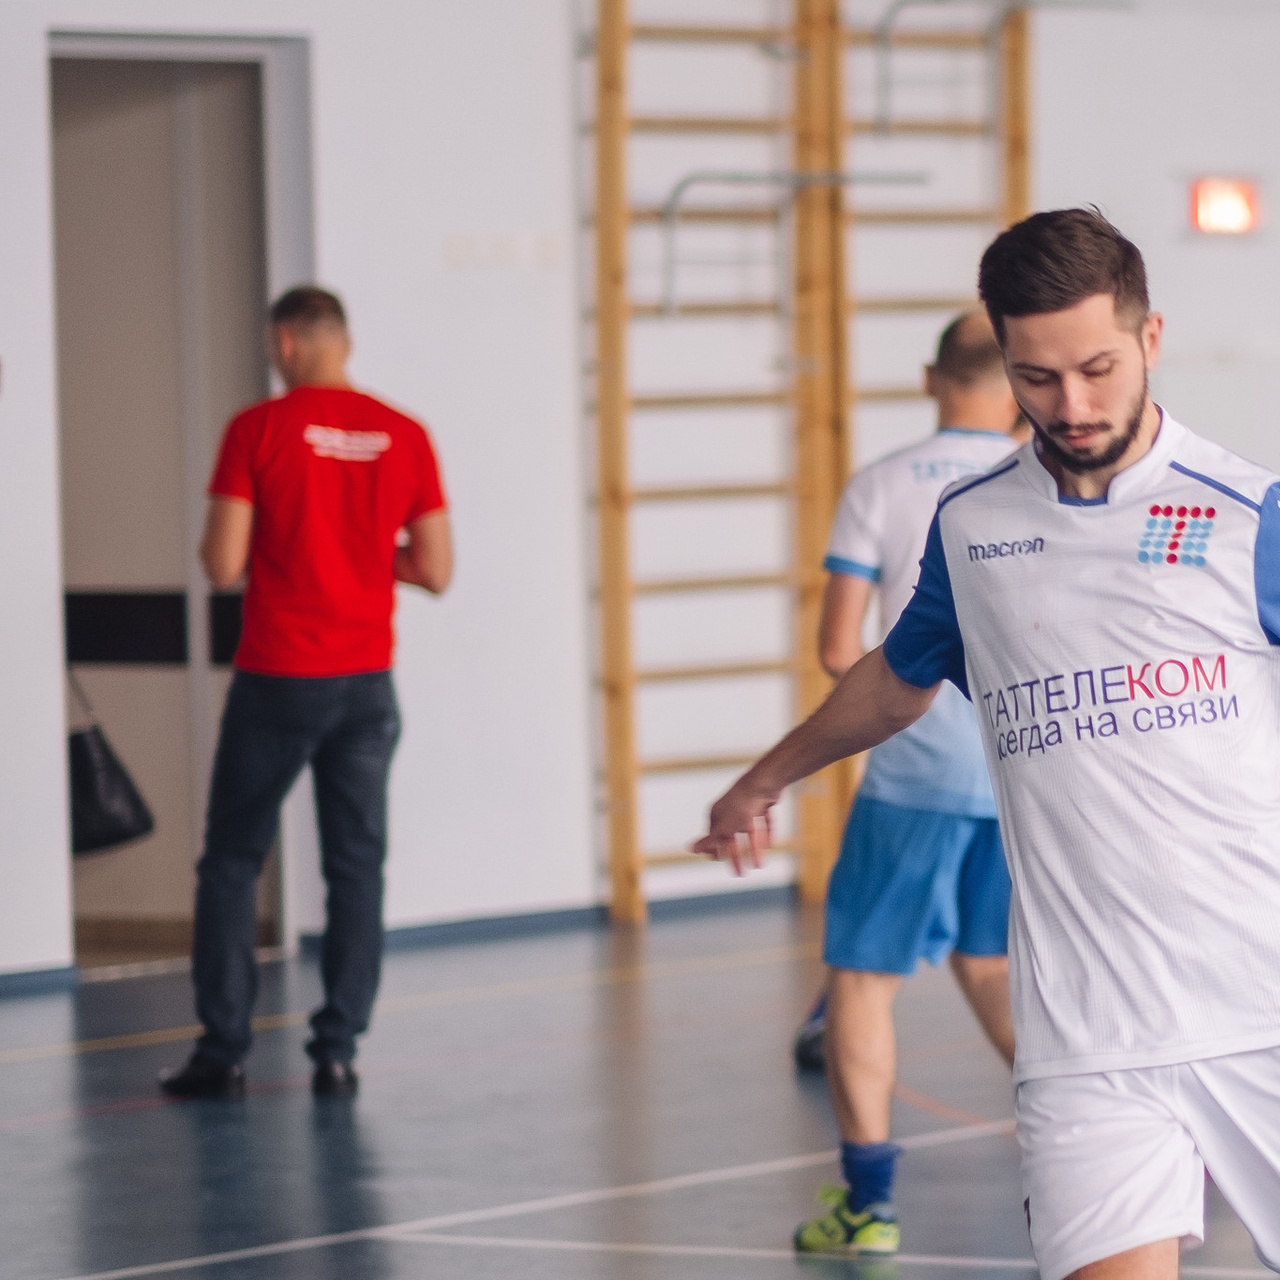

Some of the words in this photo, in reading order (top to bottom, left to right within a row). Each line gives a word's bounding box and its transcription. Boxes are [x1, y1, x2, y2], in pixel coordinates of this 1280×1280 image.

[983, 653, 1227, 731] ТАТТЕЛЕКОМ
[996, 719, 1063, 760] сегда
[1075, 709, 1119, 741] на
[1132, 694, 1240, 733] связи
